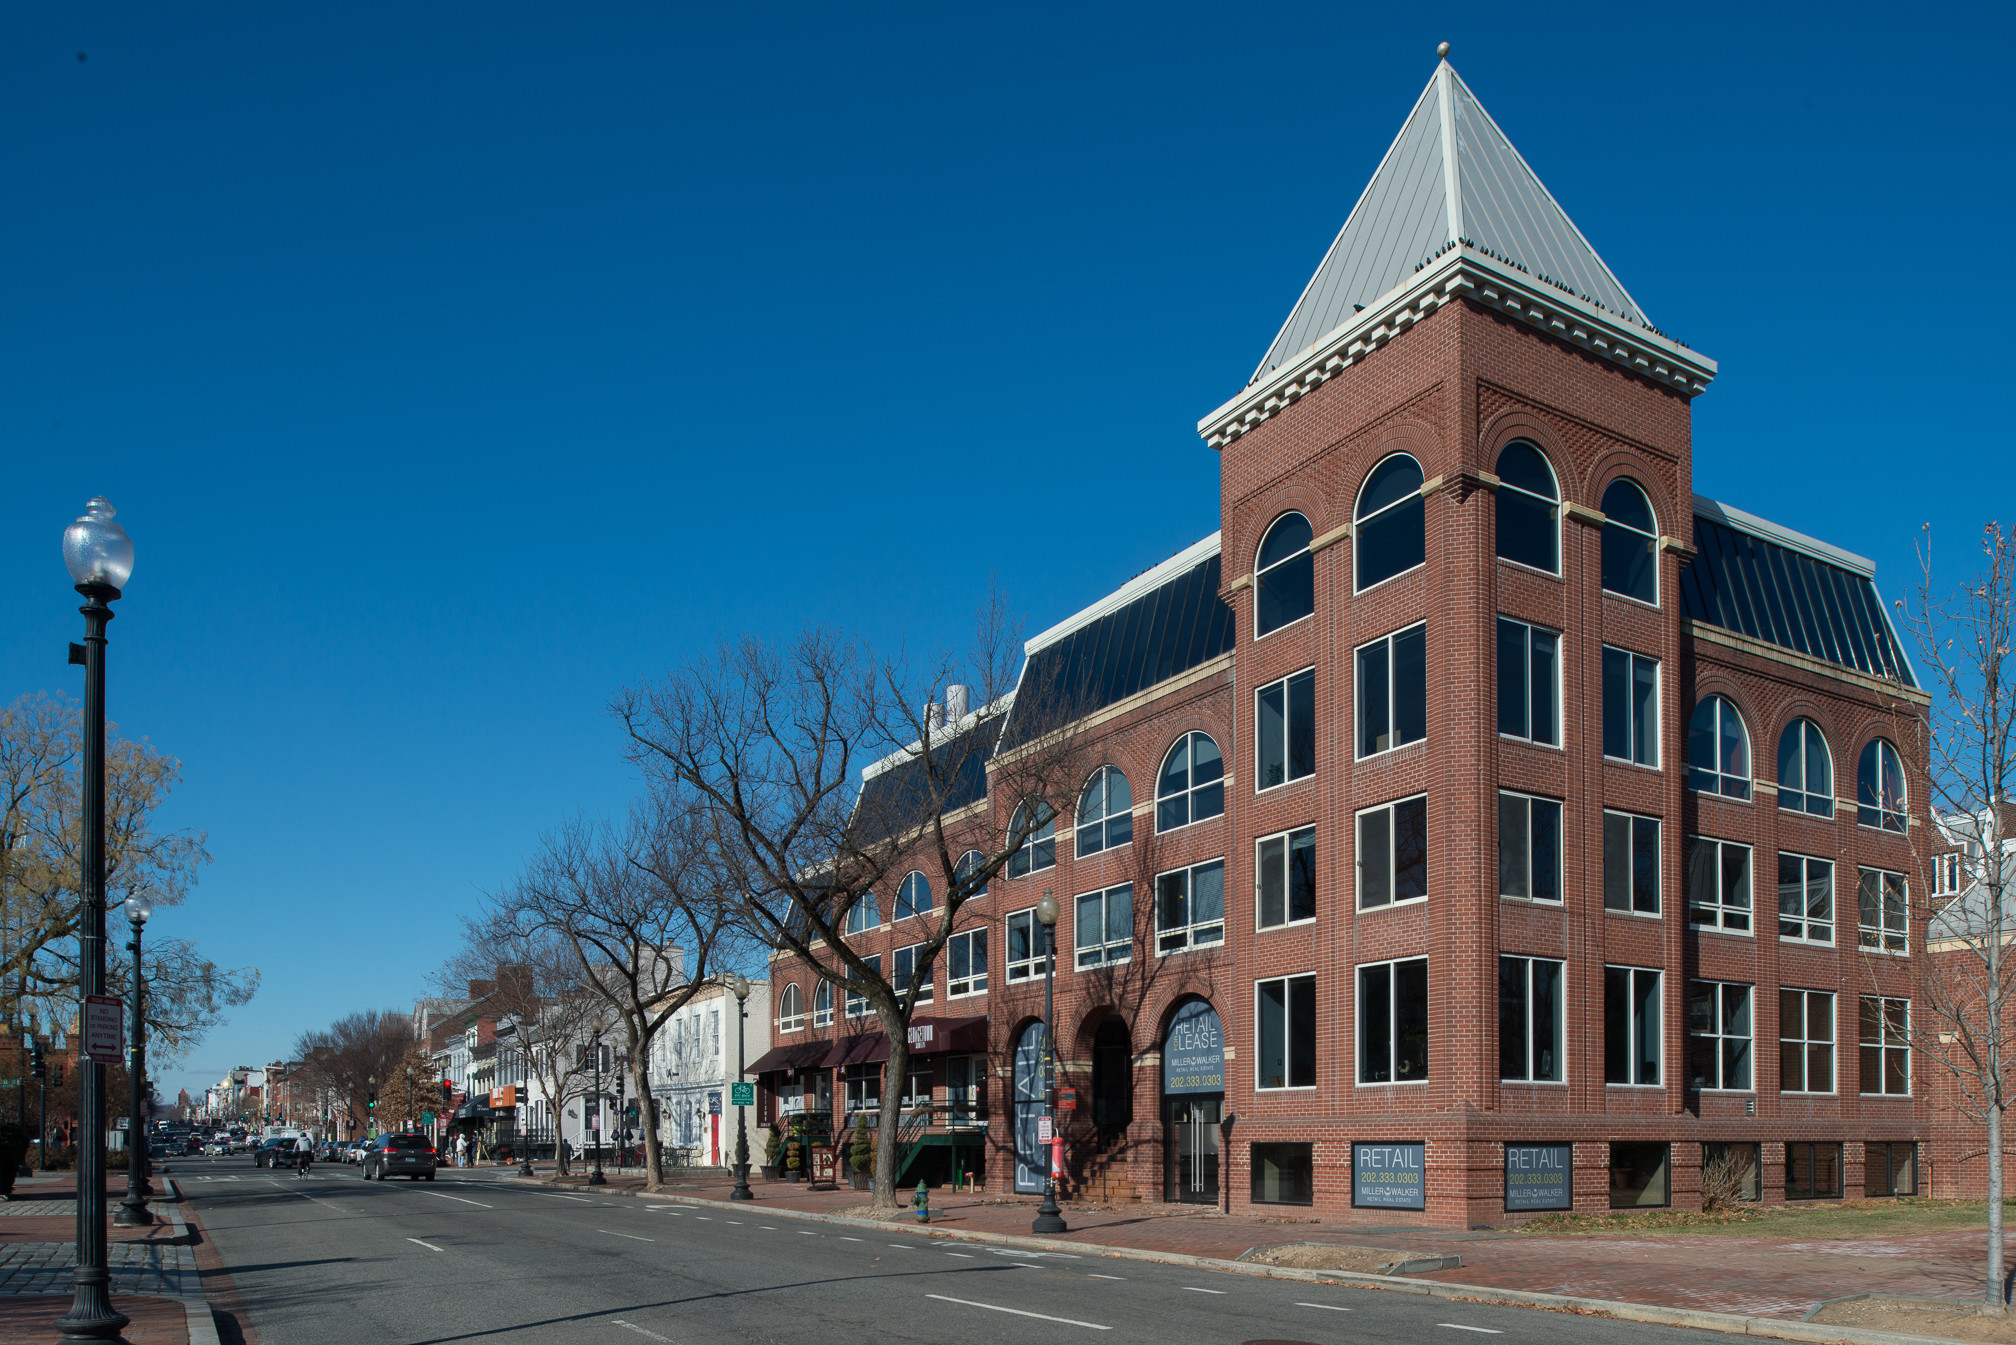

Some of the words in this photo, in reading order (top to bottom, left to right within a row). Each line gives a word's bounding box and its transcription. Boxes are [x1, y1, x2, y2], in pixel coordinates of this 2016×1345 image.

[91, 1015, 117, 1023] STANDING
[1175, 1016, 1216, 1035] RETAIL
[91, 1031, 118, 1040] ANYTIME
[1178, 1031, 1218, 1051] LEASE
[1171, 1057, 1191, 1066] MILLER
[1196, 1055, 1220, 1064] WALKER
[1170, 1074, 1222, 1088] 202.333.0303
[1360, 1148, 1419, 1168] RETAIL
[1509, 1149, 1563, 1168] RETAIL
[1361, 1171, 1419, 1184] 202.333.0303
[1509, 1173, 1563, 1185] 202.333.0303
[1361, 1186, 1384, 1196] MILLER
[1390, 1187, 1419, 1197] WALKER
[1509, 1188, 1532, 1198] MILLER
[1538, 1188, 1563, 1197] WALKER
